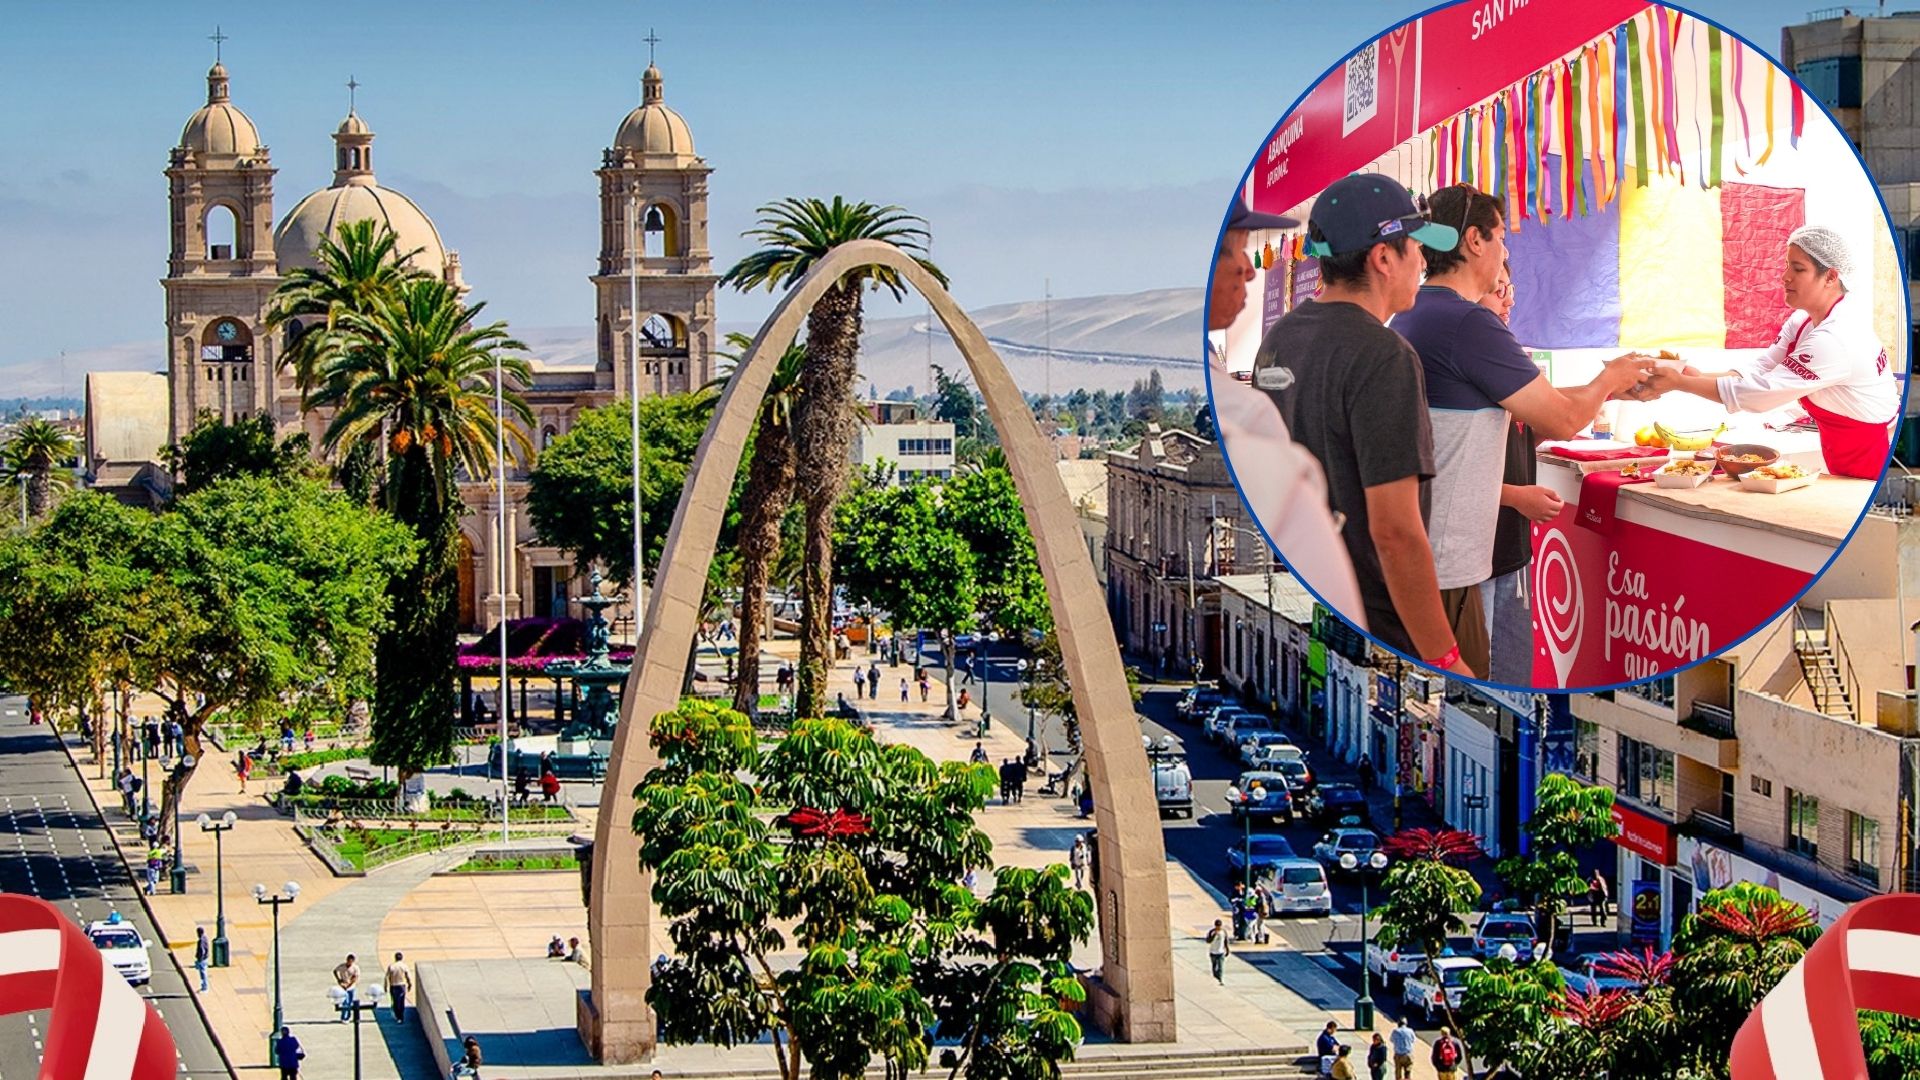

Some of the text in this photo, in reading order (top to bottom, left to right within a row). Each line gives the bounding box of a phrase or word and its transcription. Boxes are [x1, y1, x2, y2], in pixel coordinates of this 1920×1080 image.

[1471, 0, 1505, 40] SAN
[1267, 114, 1304, 165] ABANQUINA
[1607, 550, 1649, 600] Esa
[1605, 594, 1710, 662] pasión
